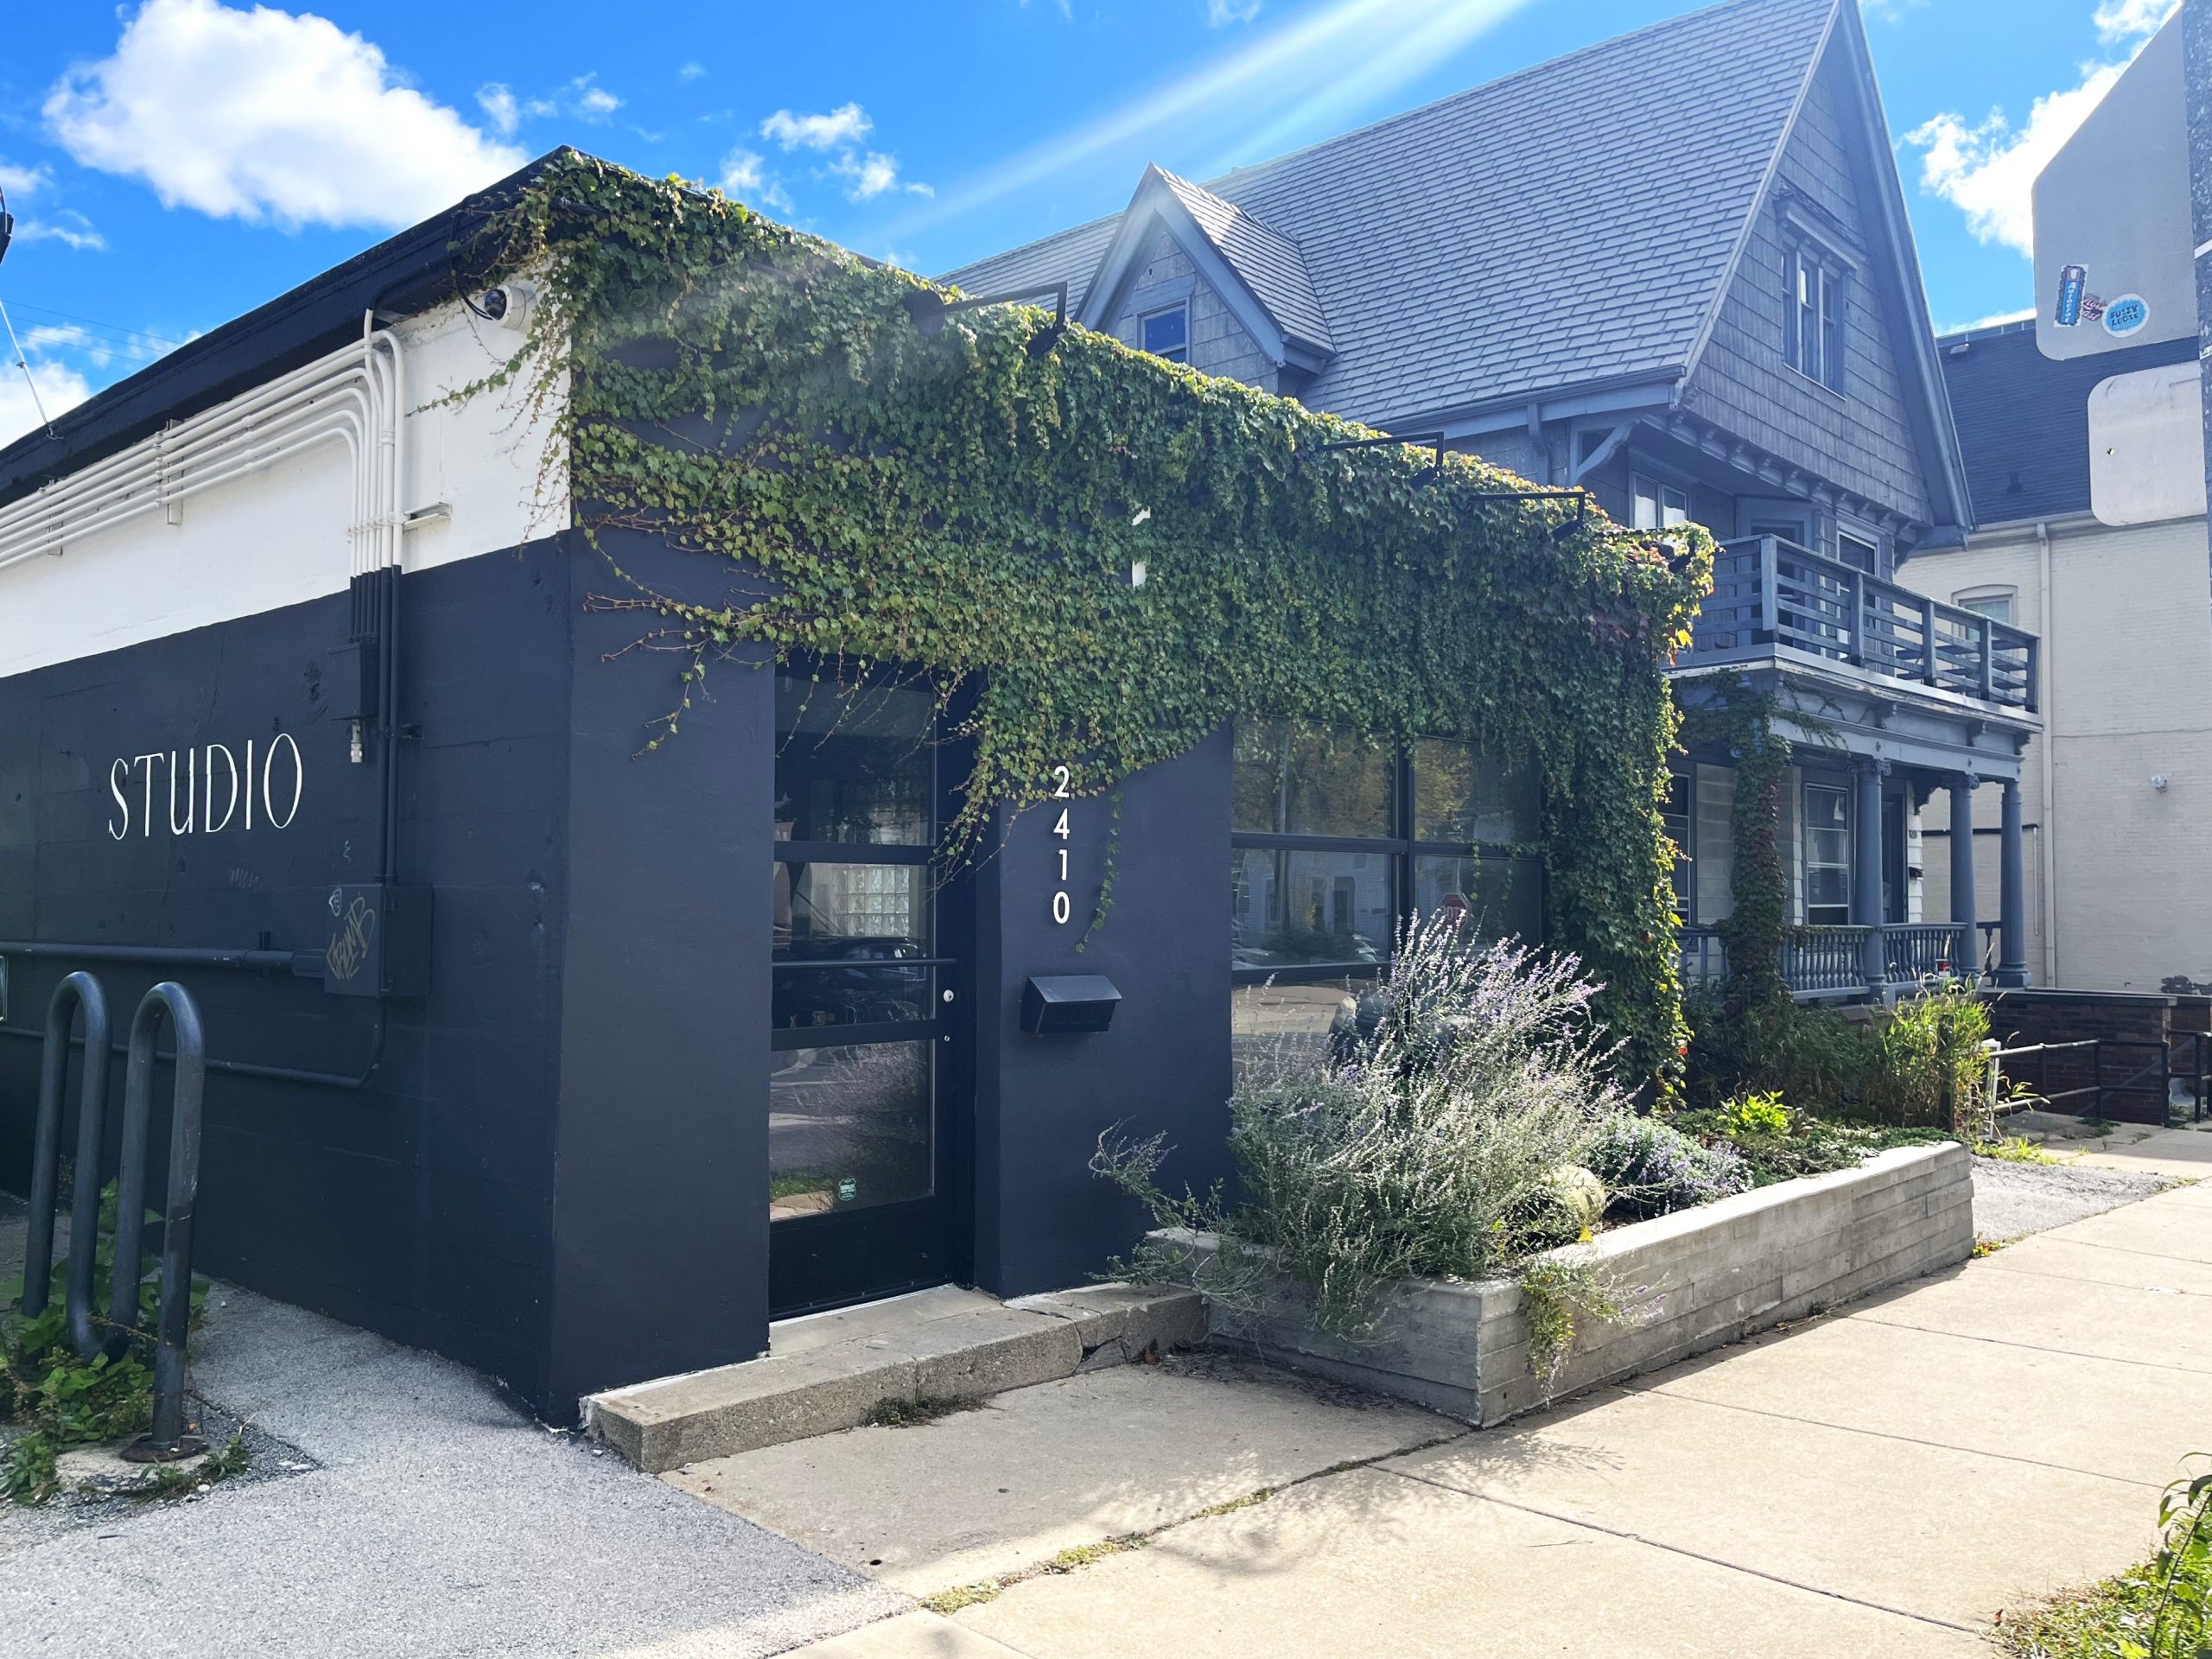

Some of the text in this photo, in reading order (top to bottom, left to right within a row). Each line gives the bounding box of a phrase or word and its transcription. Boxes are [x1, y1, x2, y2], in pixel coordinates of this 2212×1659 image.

[2110, 304, 2139, 320] FUZZY
[2112, 313, 2139, 327] LOGIC
[109, 733, 302, 840] STUDIO
[1052, 765, 1071, 925] 2410
